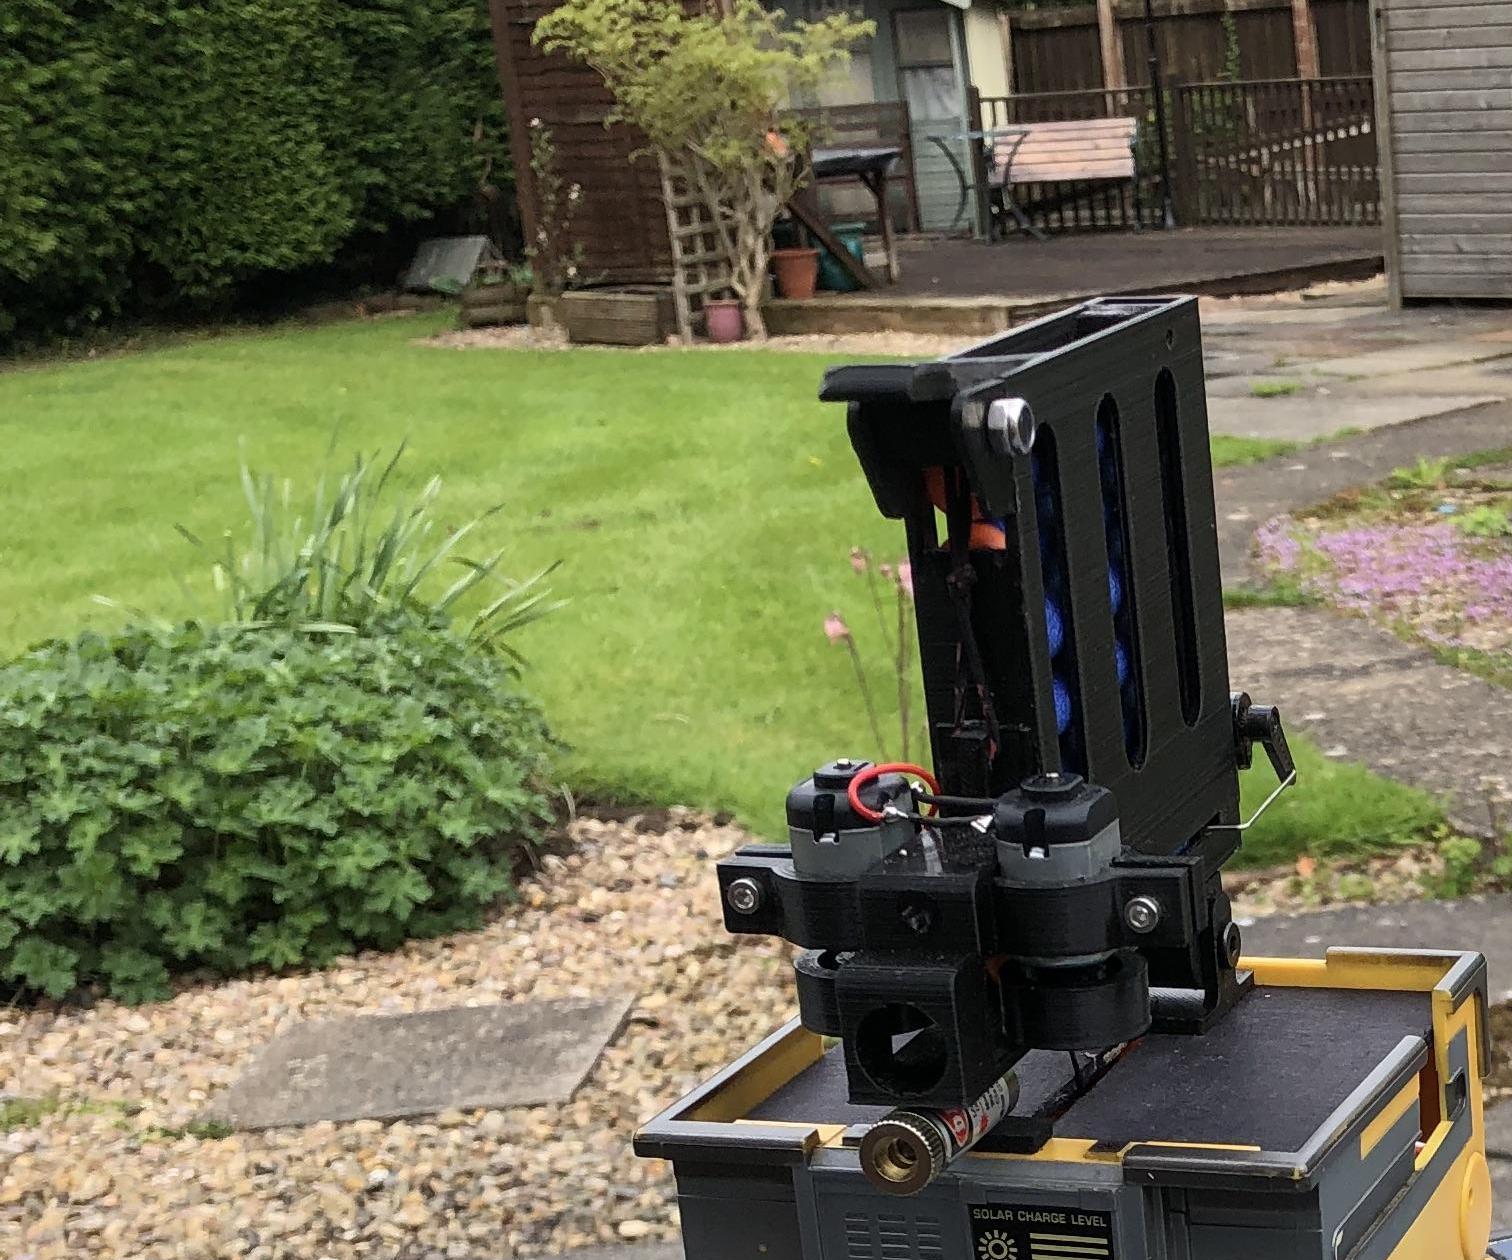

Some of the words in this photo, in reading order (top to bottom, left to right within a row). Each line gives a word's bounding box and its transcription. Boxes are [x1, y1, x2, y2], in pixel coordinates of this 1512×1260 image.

[973, 1208, 1014, 1221] SOLAR
[1017, 1210, 1067, 1224] CHARGE
[1070, 1214, 1107, 1227] LEVEL
